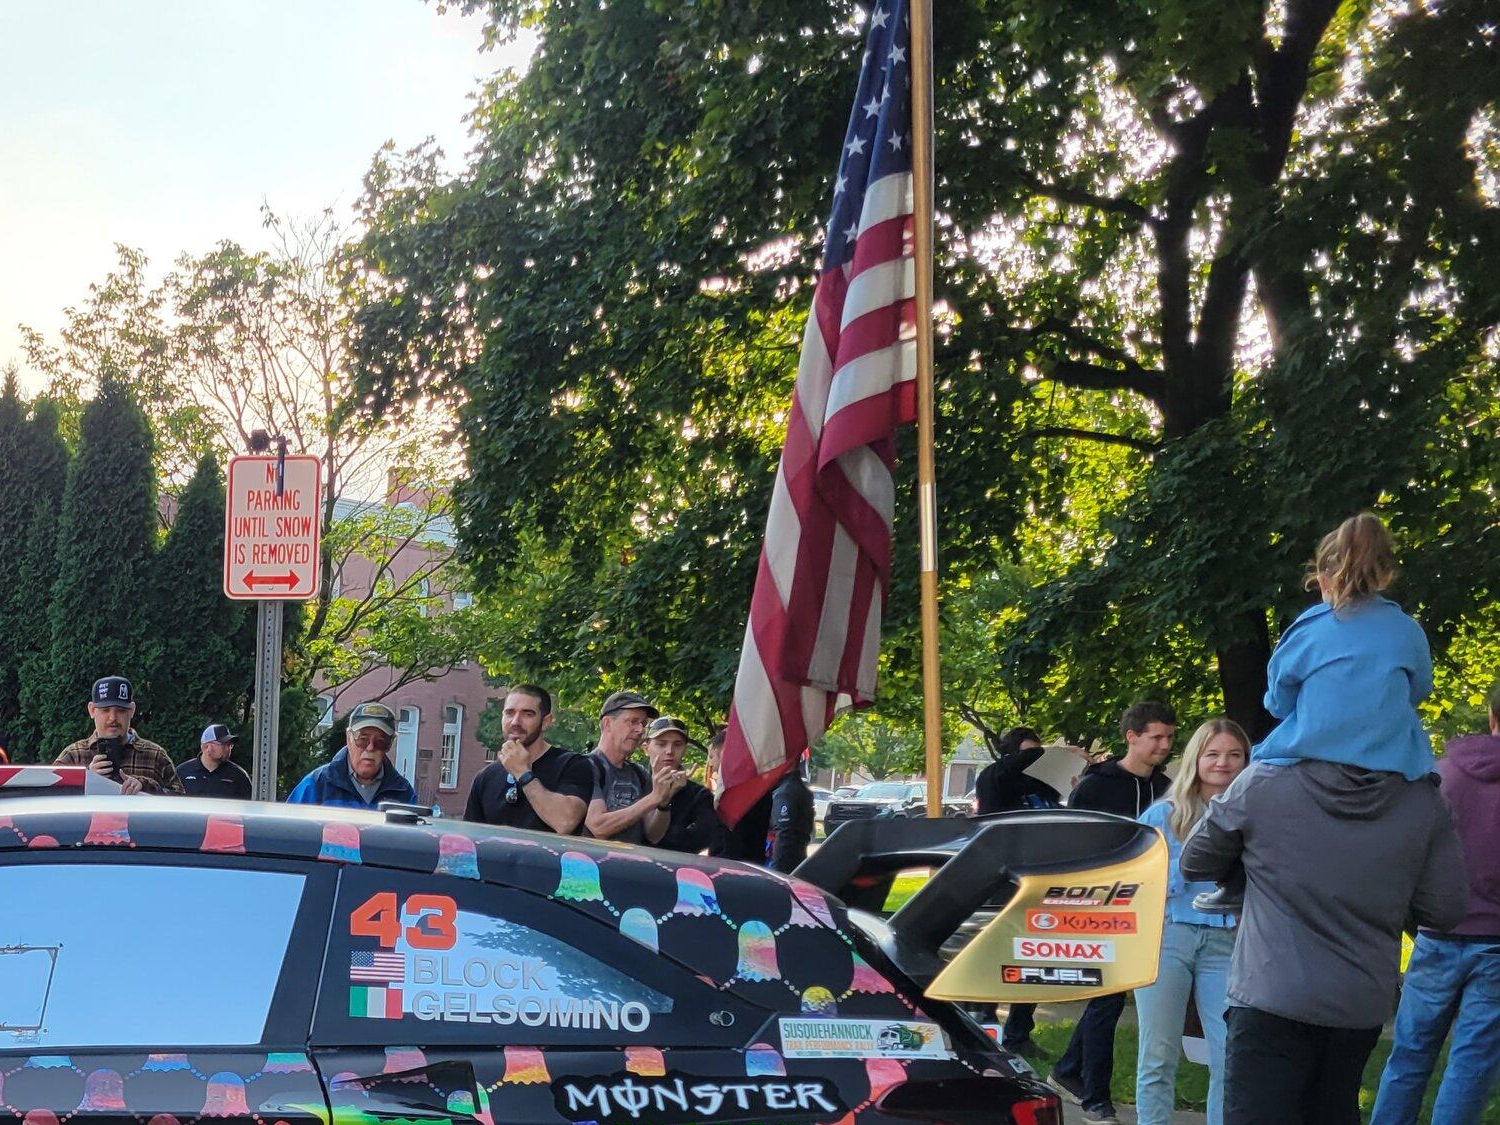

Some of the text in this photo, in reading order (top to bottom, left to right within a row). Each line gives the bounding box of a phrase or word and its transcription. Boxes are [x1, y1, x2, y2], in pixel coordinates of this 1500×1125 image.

[247, 489, 301, 511] PARKING
[234, 516, 311, 538] UNTIL SNOW
[234, 543, 310, 565] IS REMOVED
[350, 892, 458, 951] 43
[1063, 916, 1132, 930] Kubota
[1021, 941, 1105, 960] SONAX
[412, 954, 549, 991] BLOCK
[1021, 967, 1100, 981] FUEL
[411, 990, 651, 1033] GELSOMINO
[783, 1022, 874, 1041] SUSQUEHANNOCK
